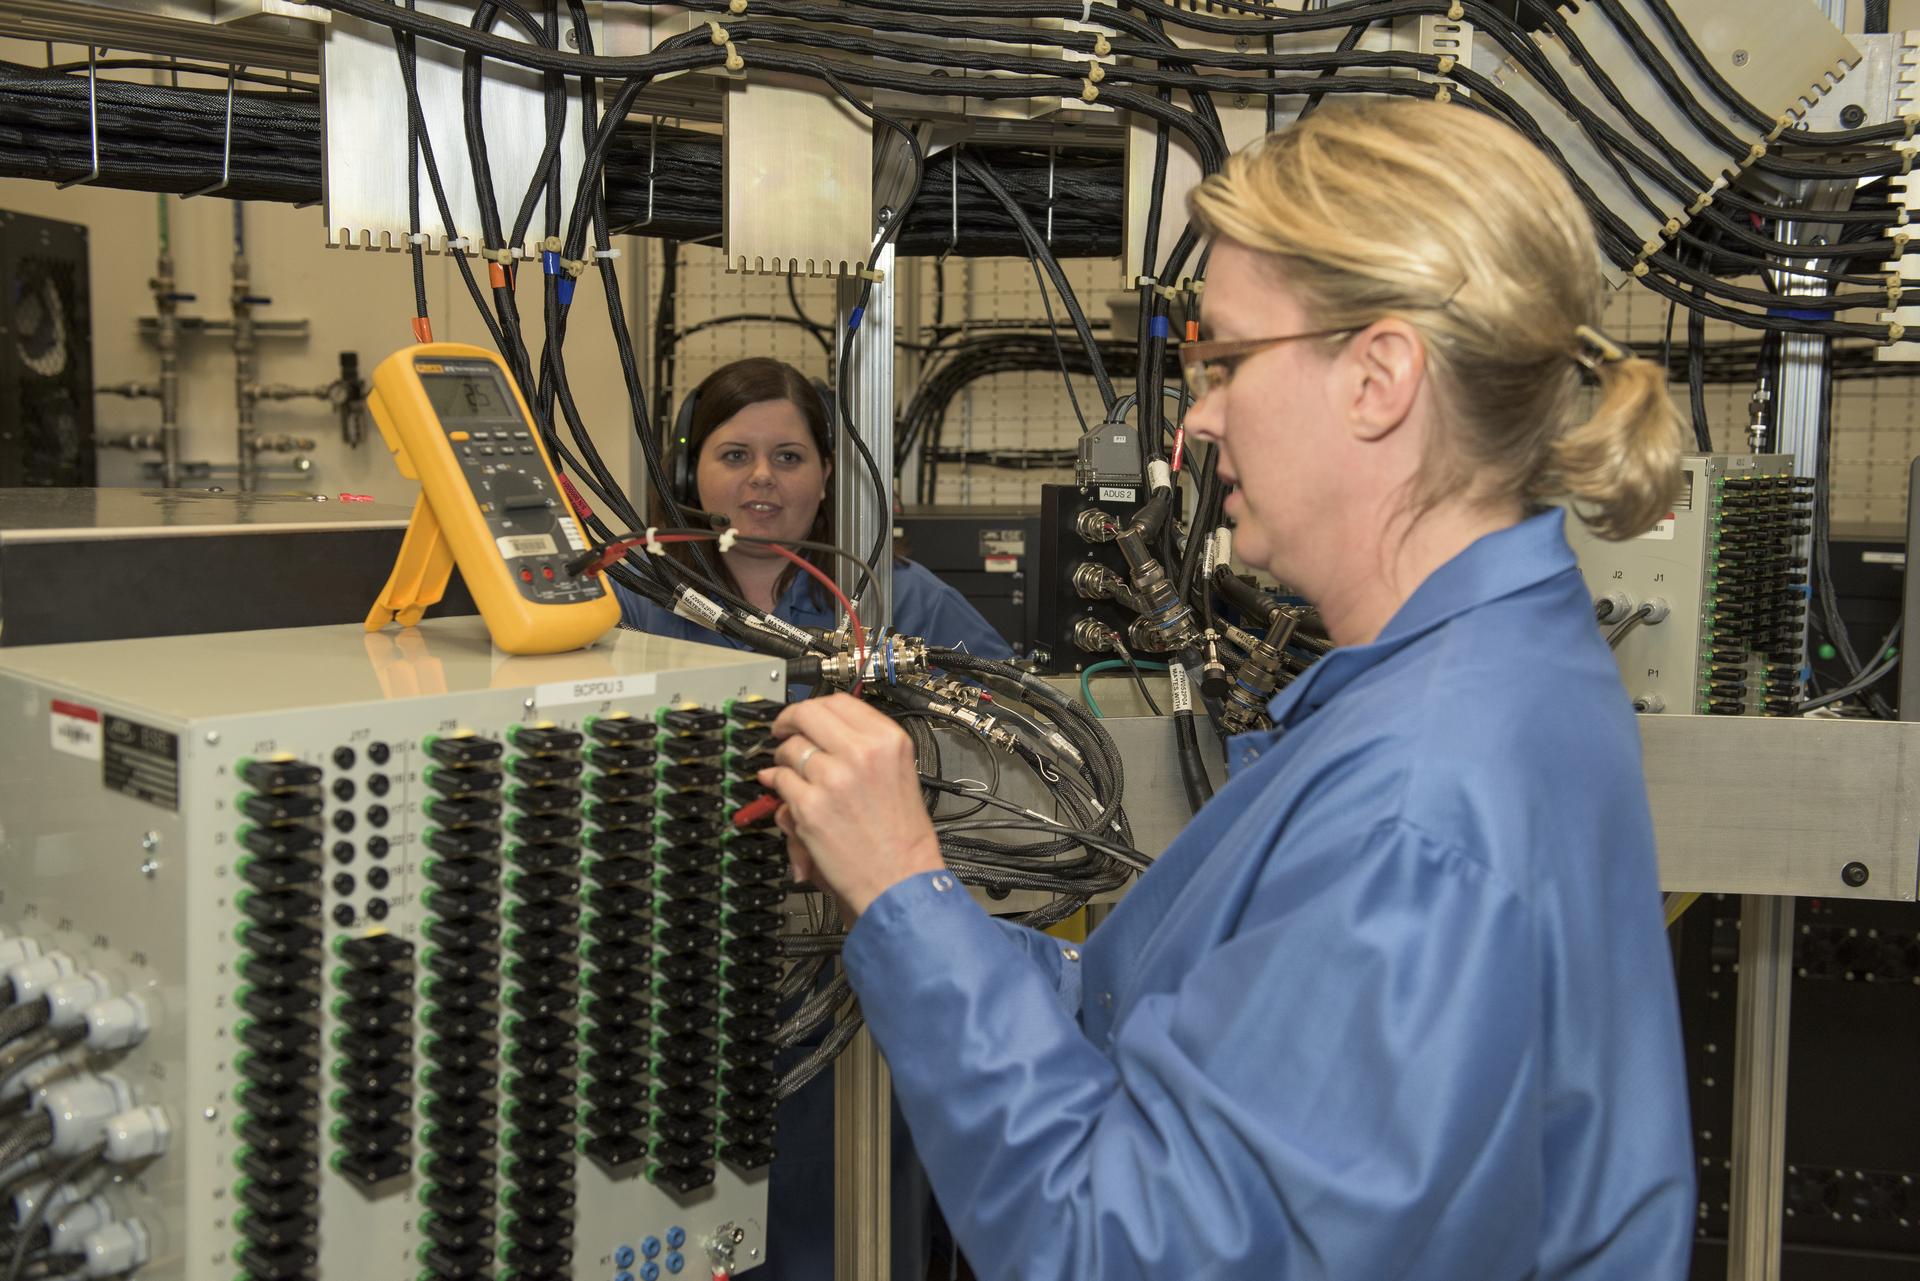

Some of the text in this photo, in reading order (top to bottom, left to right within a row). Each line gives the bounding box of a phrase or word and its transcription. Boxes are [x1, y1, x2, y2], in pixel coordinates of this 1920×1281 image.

[1104, 489, 1132, 499] ADUS 2
[1612, 570, 1623, 580] J2
[1653, 573, 1664, 582] J1
[1647, 668, 1659, 678] P1
[617, 680, 624, 692] 3
